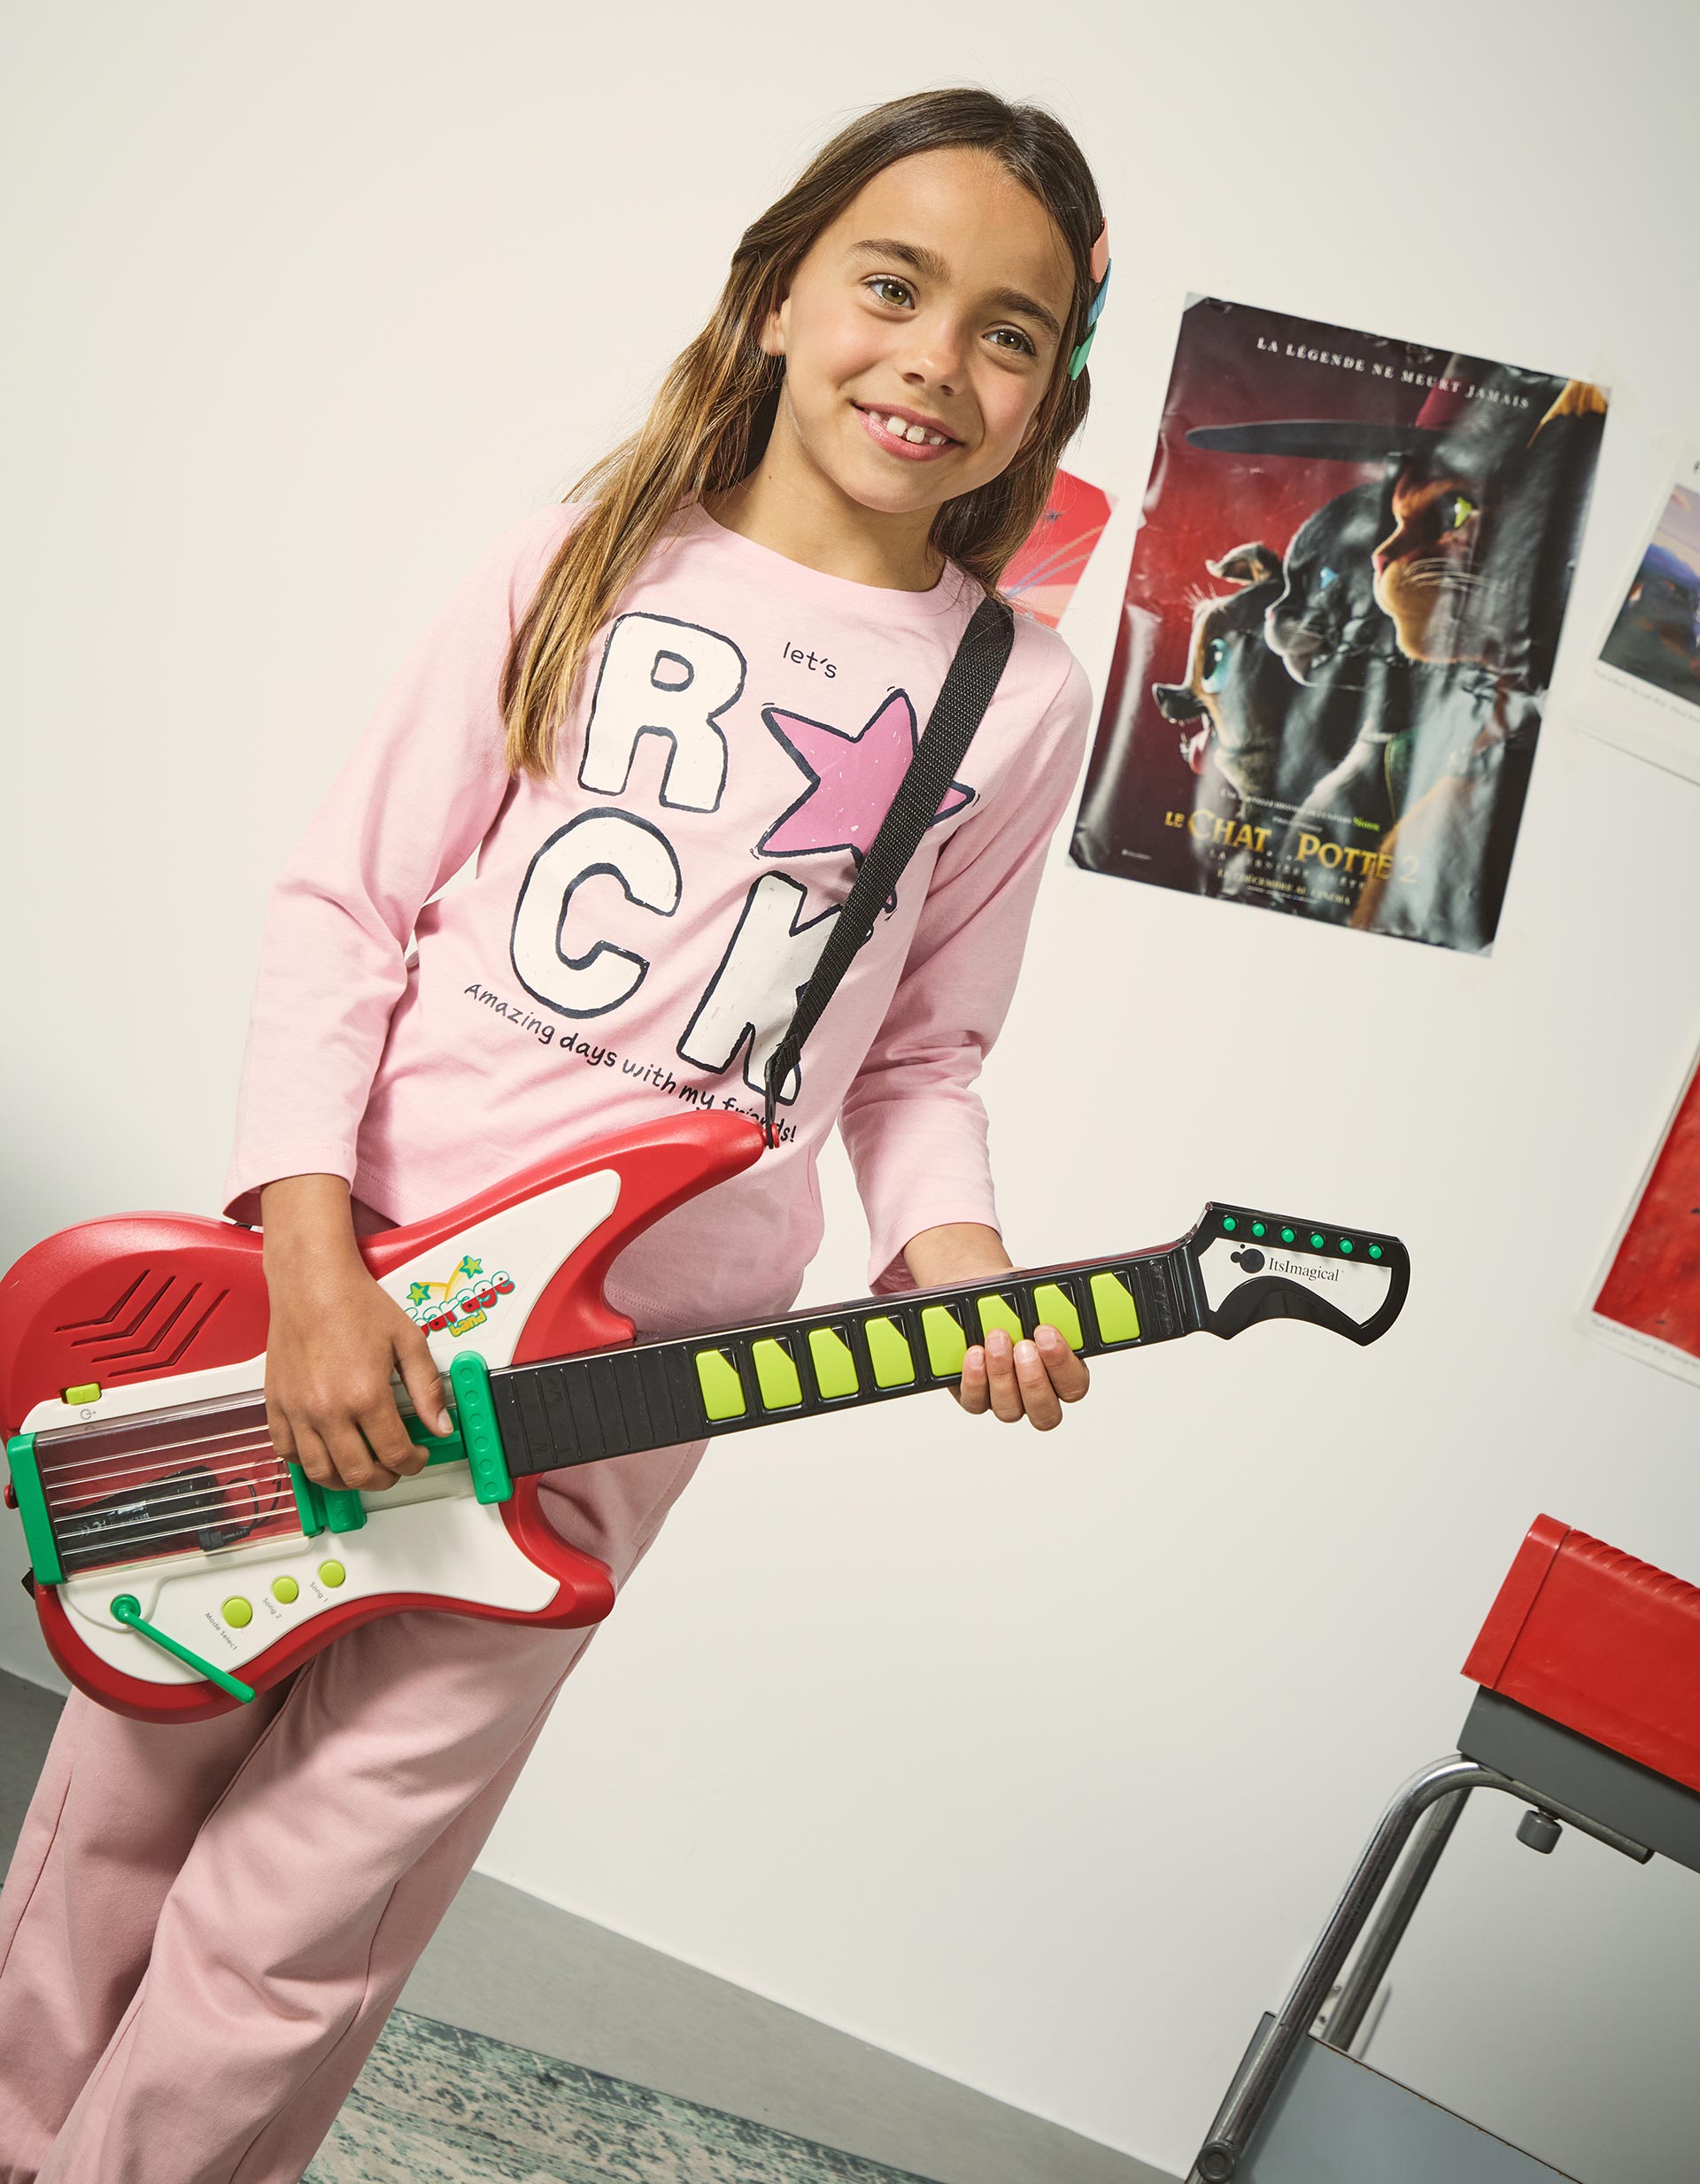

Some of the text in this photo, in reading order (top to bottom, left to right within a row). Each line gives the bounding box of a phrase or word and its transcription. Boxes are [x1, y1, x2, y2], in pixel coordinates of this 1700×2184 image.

[1256, 336, 1529, 410] LA LÉGENDE NE MEURT JAMAIS
[783, 641, 838, 679] let's
[1164, 811, 1186, 829] LE
[1187, 808, 1273, 853] CHAT
[463, 984, 556, 1046] Amazing
[559, 1032, 618, 1068] days
[622, 1059, 677, 1095] with
[1269, 1257, 1340, 1282] ItsImagical
[262, 1597, 277, 1617] Song
[309, 1581, 324, 1600] Song
[205, 1611, 238, 1651] Mode Select
